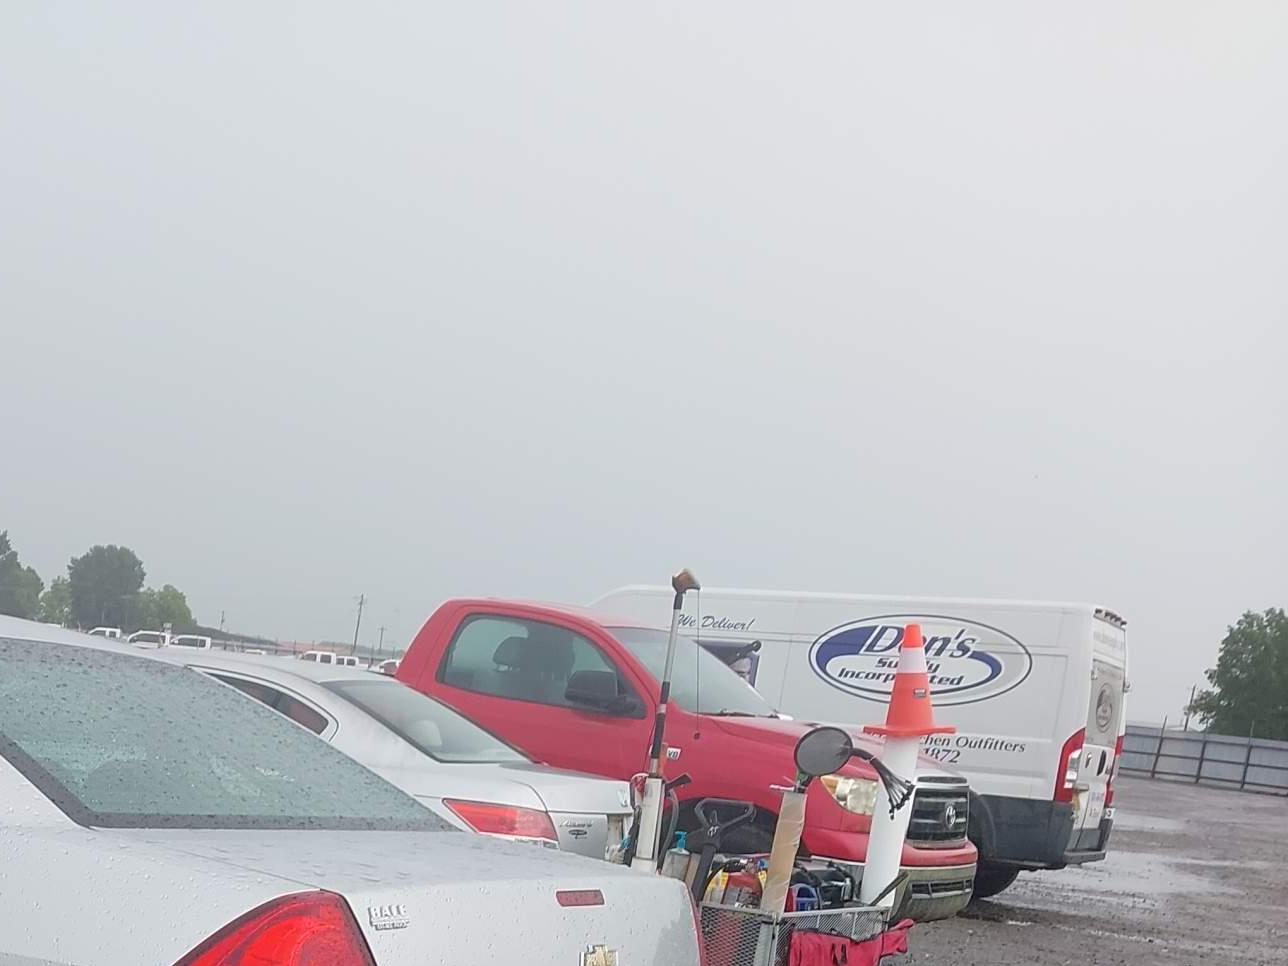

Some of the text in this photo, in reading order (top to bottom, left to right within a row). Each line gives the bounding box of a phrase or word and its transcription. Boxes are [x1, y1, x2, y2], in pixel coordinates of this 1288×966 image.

[678, 614, 755, 632] We Deliver!
[874, 657, 941, 674] Suy
[838, 667, 965, 687] Incorpted
[955, 735, 1027, 754] Outfitters
